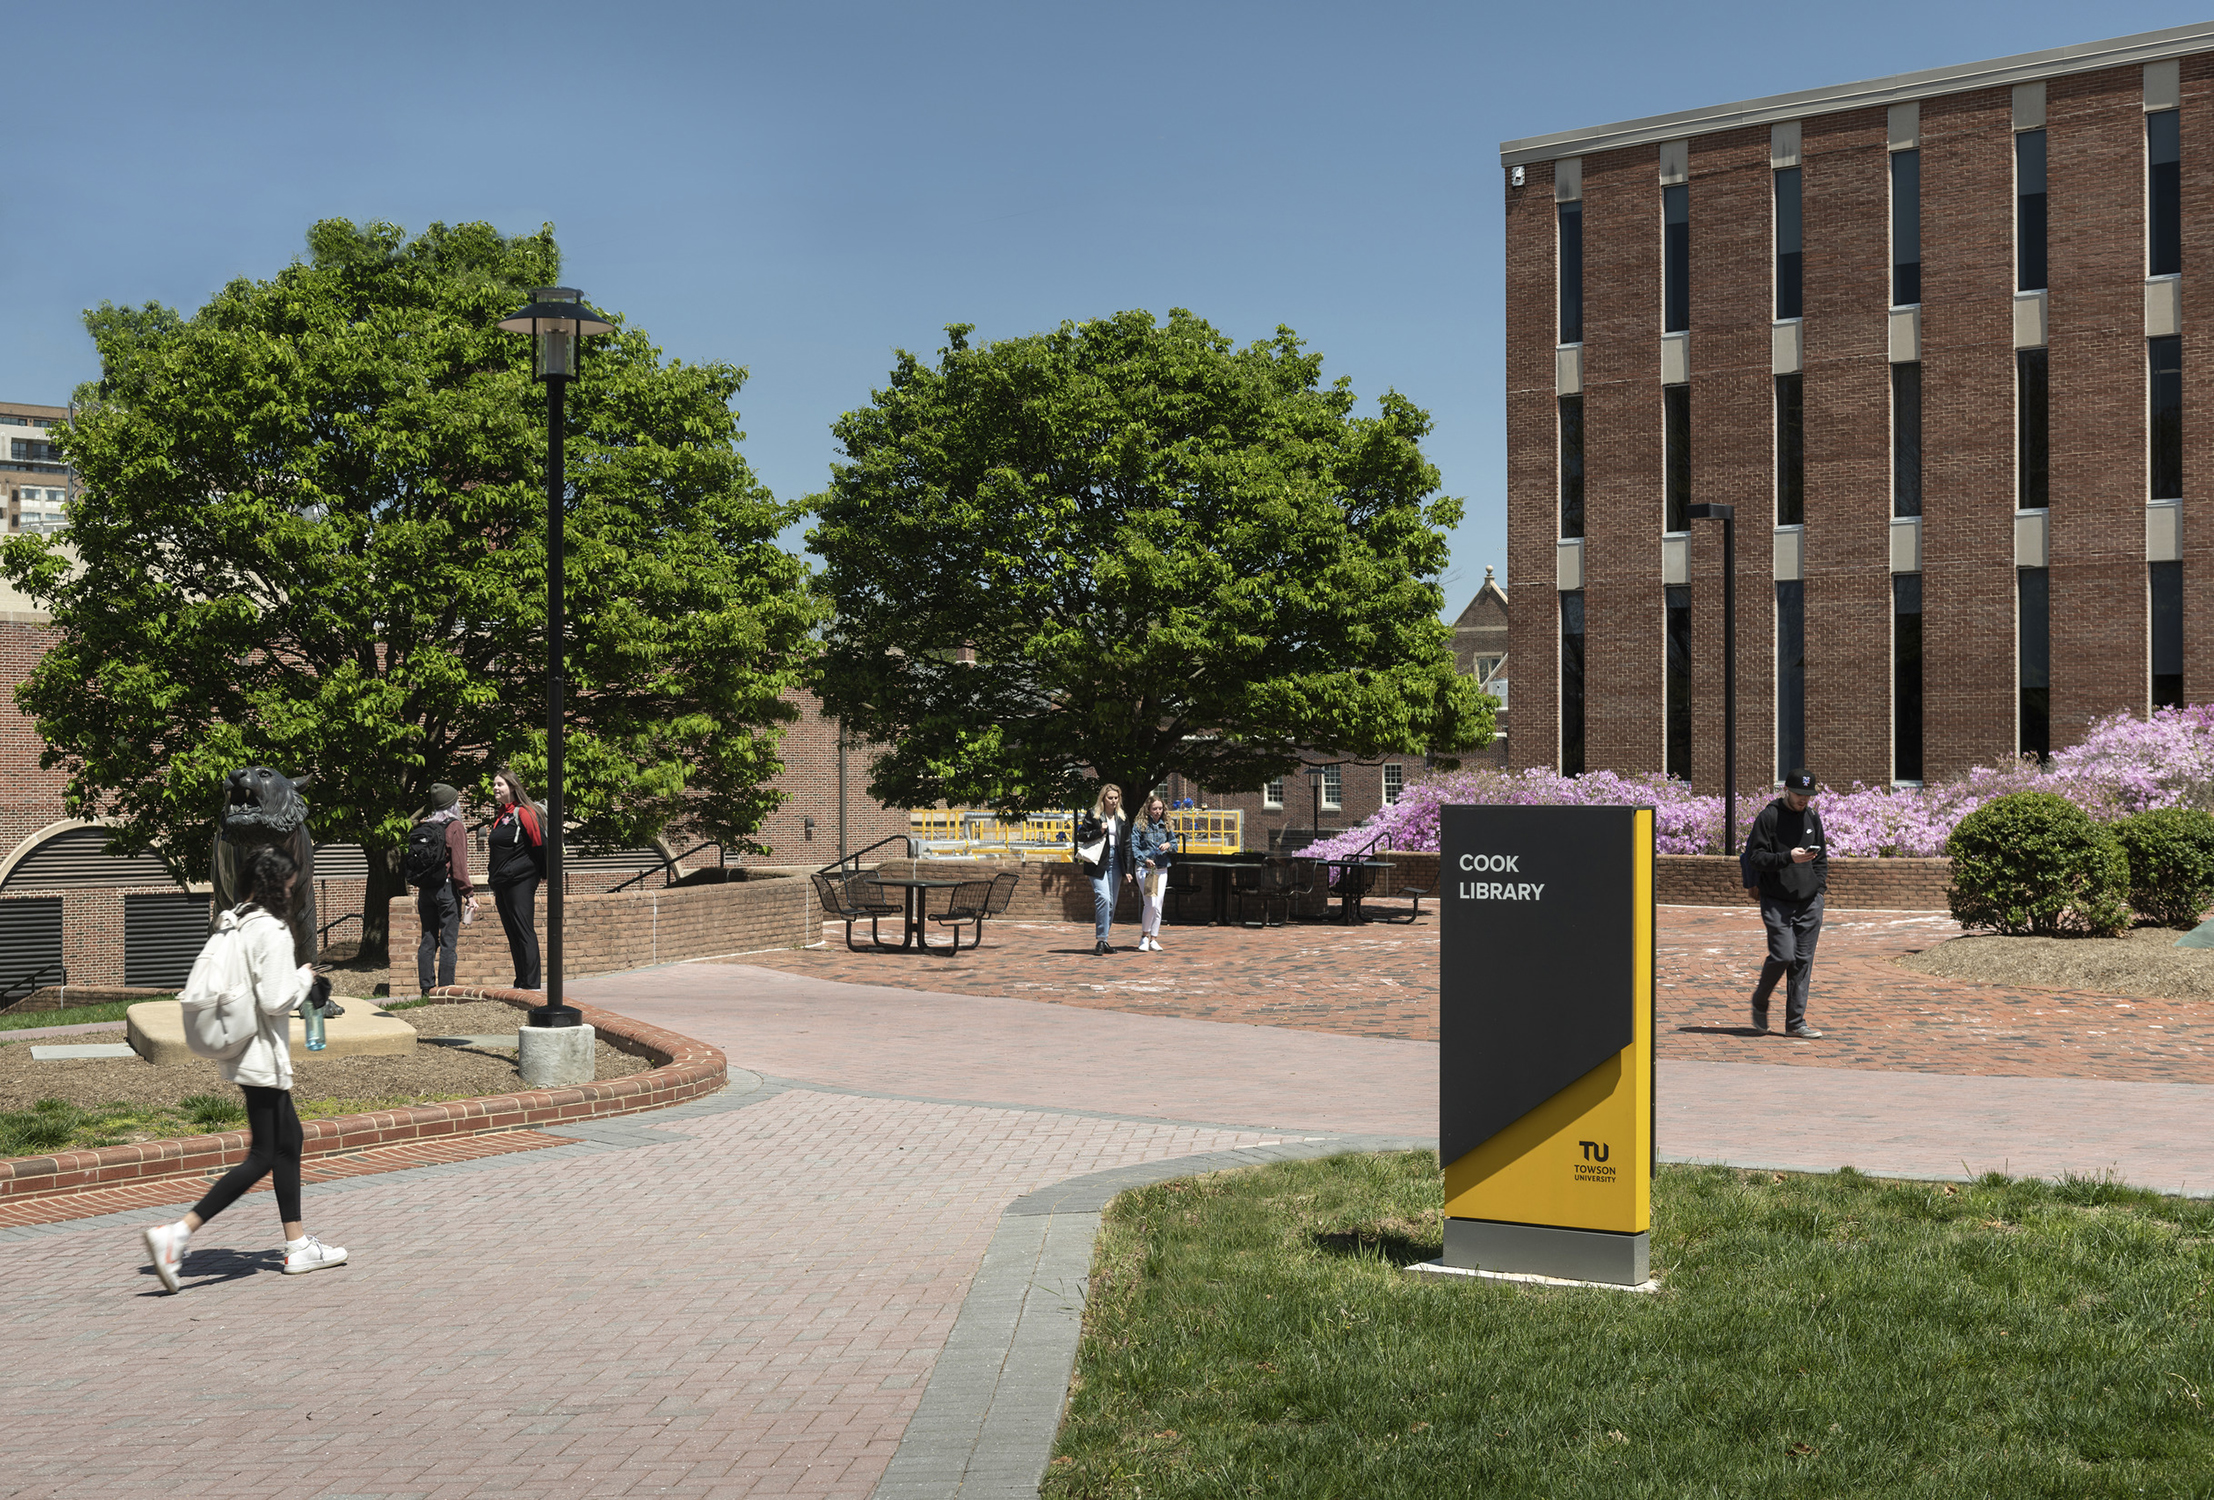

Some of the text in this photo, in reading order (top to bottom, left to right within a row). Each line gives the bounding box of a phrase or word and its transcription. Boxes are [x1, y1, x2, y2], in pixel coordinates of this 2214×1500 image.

[1459, 853, 1520, 873] COOK
[1459, 882, 1546, 901] LIBRARY
[1578, 1141, 1609, 1163] TU
[1574, 1164, 1616, 1175] TOWSON
[1574, 1174, 1616, 1183] UNIVERSITY
